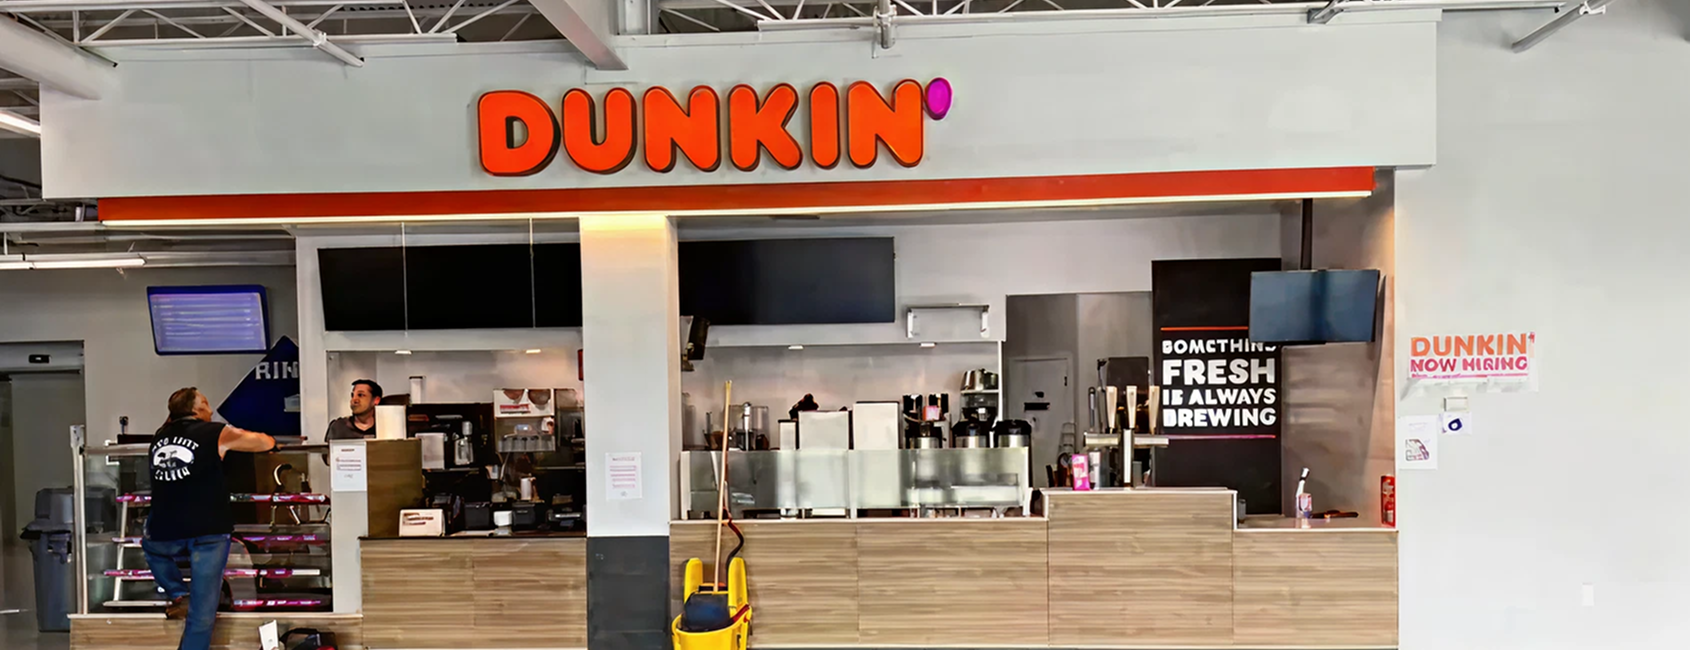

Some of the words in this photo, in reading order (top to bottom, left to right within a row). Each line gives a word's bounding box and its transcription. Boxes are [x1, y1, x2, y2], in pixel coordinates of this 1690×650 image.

[478, 77, 953, 177] DUNKIN'
[1162, 358, 1275, 385] FRESH
[1410, 358, 1457, 372] NOW
[1462, 356, 1528, 371] HIRING
[1188, 388, 1276, 405] ALWAYS
[1162, 408, 1276, 427] BREWING
